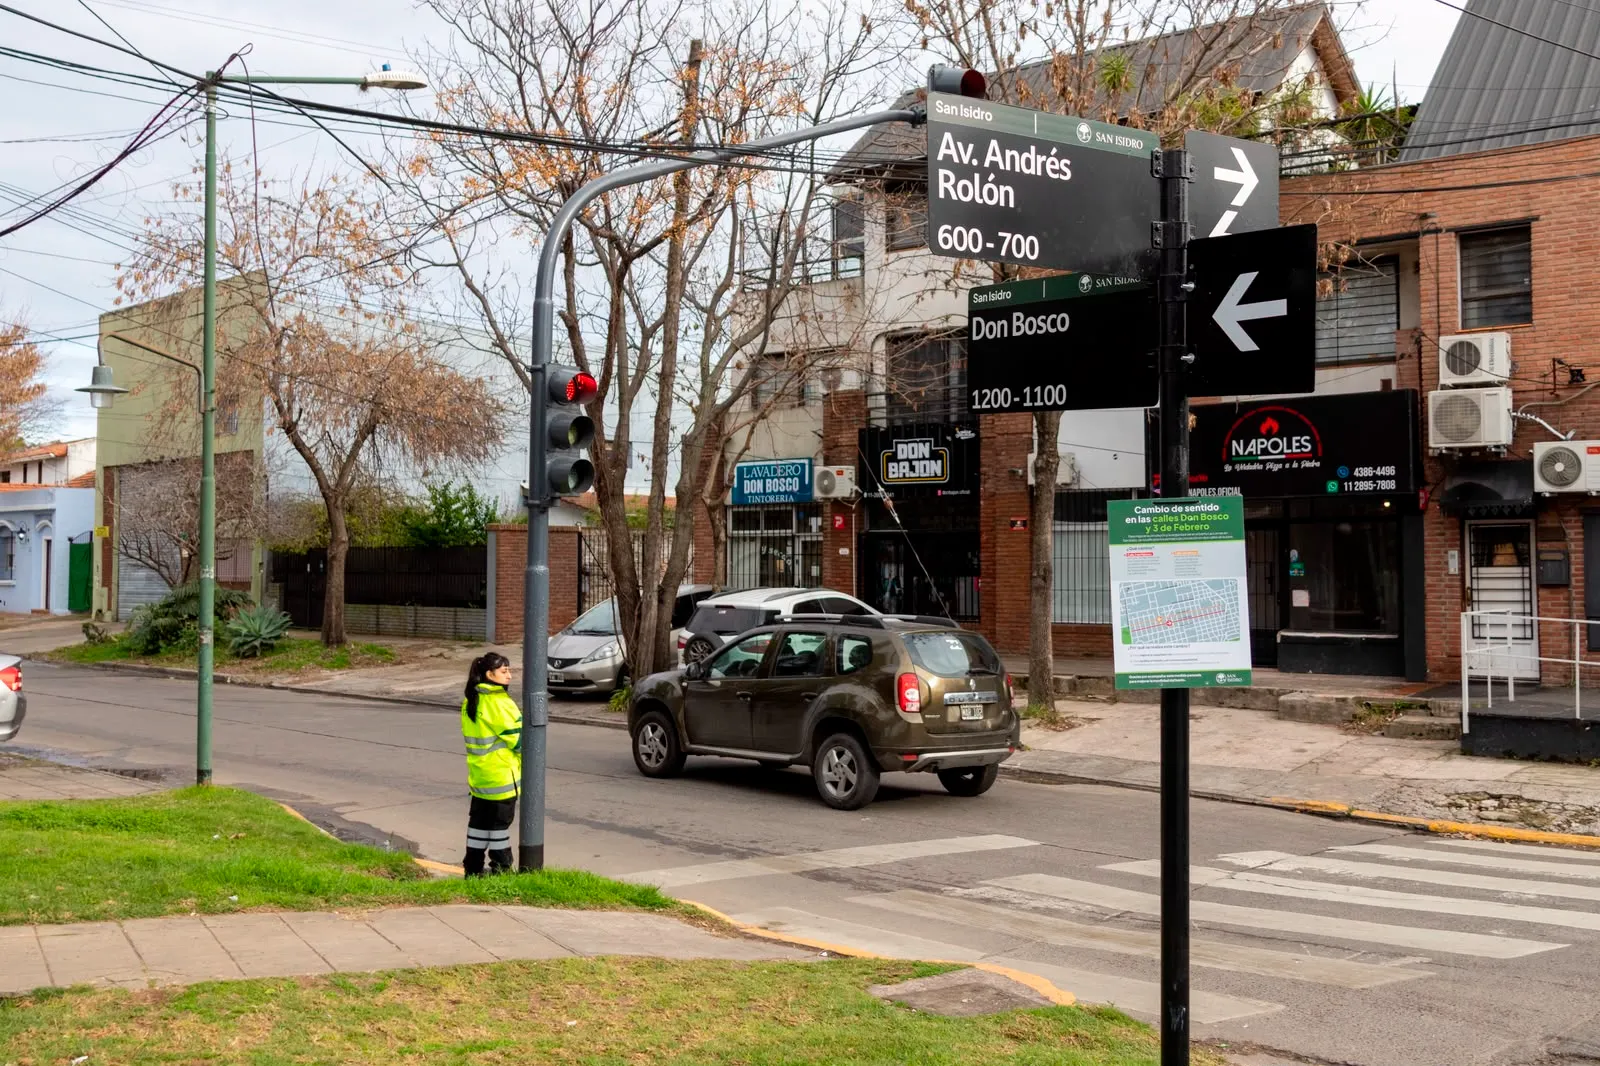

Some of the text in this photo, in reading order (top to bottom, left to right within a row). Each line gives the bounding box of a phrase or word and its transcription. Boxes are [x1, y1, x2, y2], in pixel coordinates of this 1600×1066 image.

[935, 100, 993, 122] San Isidro
[1096, 131, 1143, 150] SAN ISIDRO
[937, 132, 1072, 181] Av. Andrés
[938, 168, 1015, 208] Rolón
[1096, 277, 1113, 288] SAN
[973, 290, 1012, 304] San Isidro
[972, 311, 1070, 341] Don Bosco
[897, 442, 930, 460] DON
[1232, 435, 1312, 456] NAPOLES
[743, 464, 801, 479] LAVADERO
[888, 460, 942, 479] BAJON
[1353, 466, 1396, 477] 4386-4496
[743, 477, 800, 494] DON BOSCO
[1344, 480, 1396, 491] 11 2895-7808
[747, 494, 795, 504] TINTORERIA
[1134, 503, 1219, 514] Cambio de sentido
[1138, 515, 1151, 523] las
[1152, 514, 1179, 523] calles
[1180, 513, 1199, 522] Don
[1200, 512, 1229, 522] Bosco
[1145, 522, 1210, 534] y 3 de Febrero
